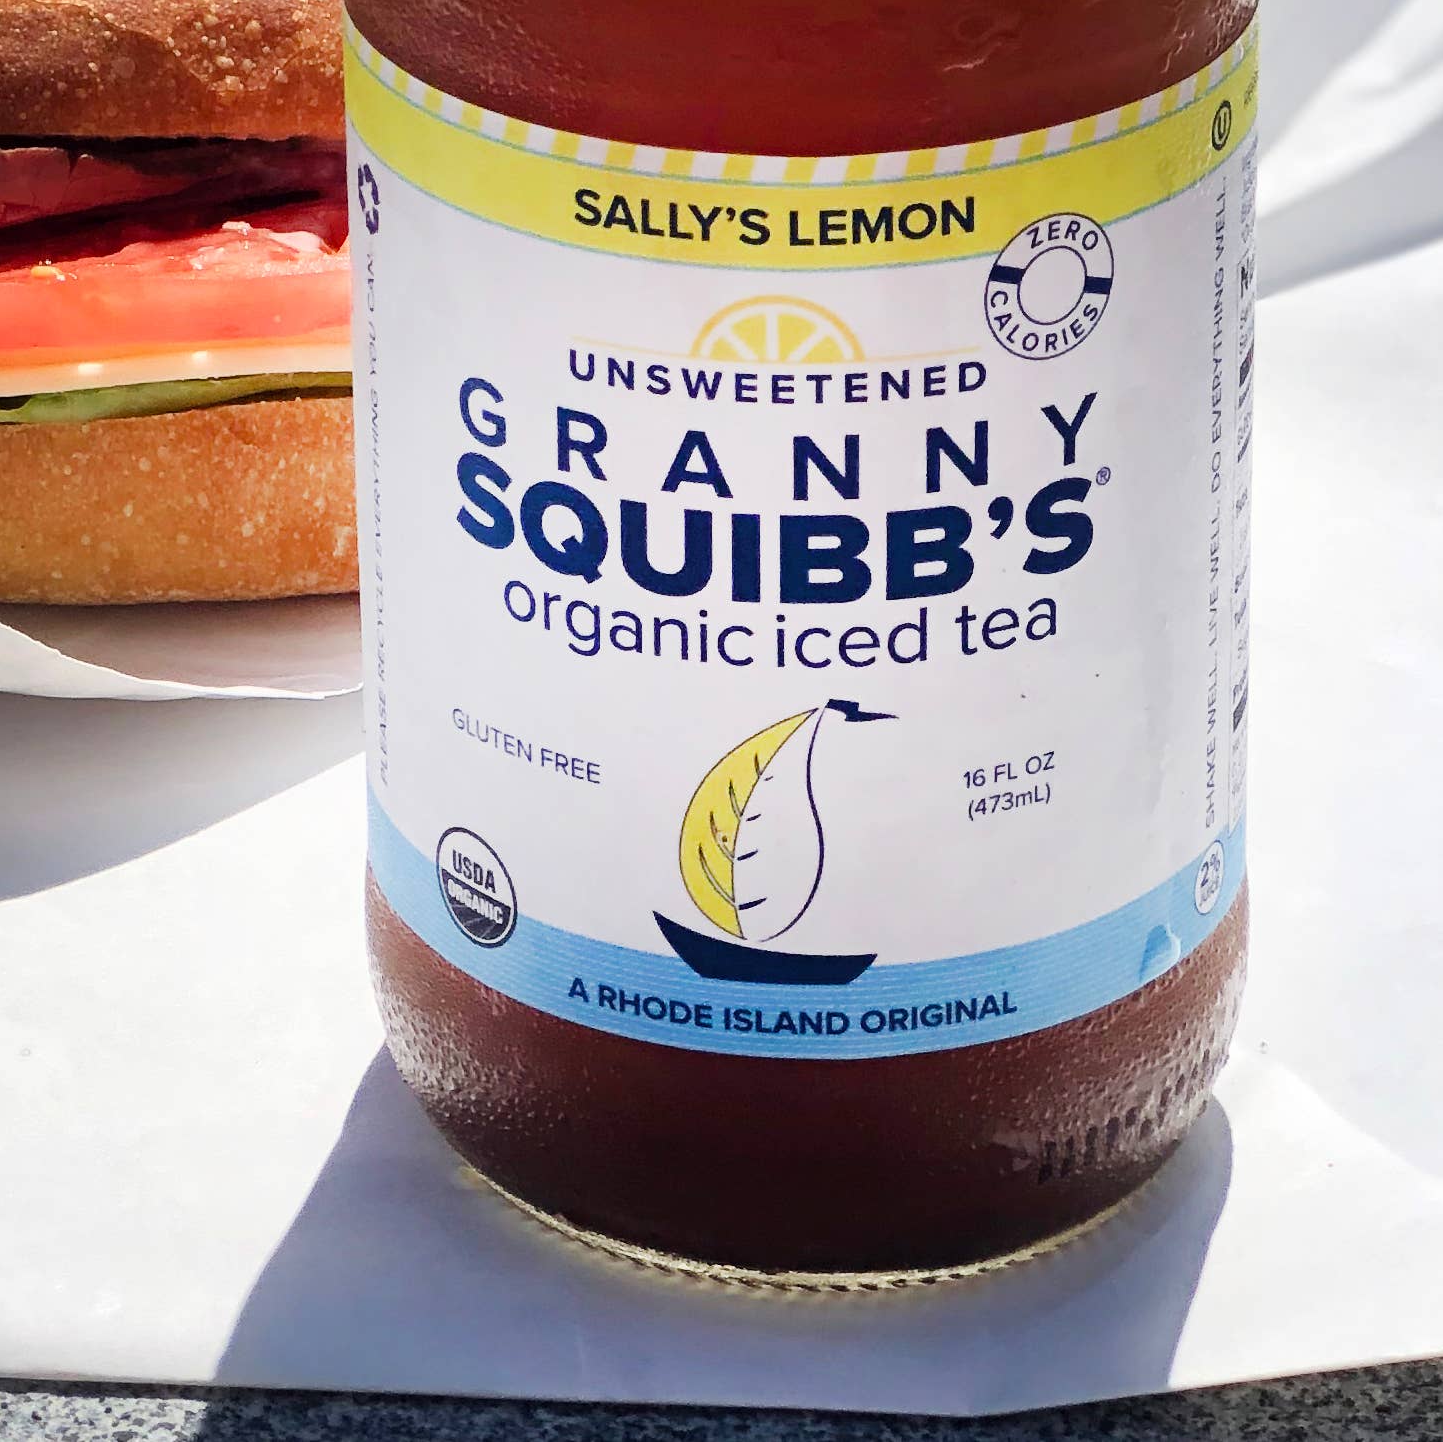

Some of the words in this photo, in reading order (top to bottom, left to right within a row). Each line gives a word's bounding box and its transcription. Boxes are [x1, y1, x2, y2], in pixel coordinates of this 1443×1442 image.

[574, 188, 770, 246] SALLY'S
[788, 195, 976, 248] LEMON
[1025, 220, 1099, 251] ZERO
[368, 320, 378, 376] YOU
[990, 290, 1098, 353] CALORIES
[569, 348, 987, 405] UNSWEETENED
[1211, 266, 1225, 444] EVERYTHING
[459, 376, 1099, 501] GRANNY
[369, 387, 383, 558] EVERYTHING
[1210, 451, 1222, 494] DO
[374, 563, 386, 682] RECYCLE
[503, 579, 755, 668] organic
[775, 606, 929, 668] iced
[954, 596, 1058, 656] tea
[1207, 586, 1219, 647] LIVE
[374, 688, 388, 787] PLEASE
[452, 708, 533, 764] GLUTEN
[540, 747, 601, 784] FREE
[963, 768, 987, 789] 16
[994, 762, 1018, 783] FL
[1025, 750, 1055, 775] OZ
[1205, 736, 1217, 829] SHAKE
[968, 781, 1051, 822] (473mL)
[452, 849, 497, 894] USDA
[567, 976, 590, 1004] A
[597, 984, 714, 1029] RHODE
[723, 1007, 851, 1036] ISLAND
[860, 990, 1018, 1034] ORIGINAL
